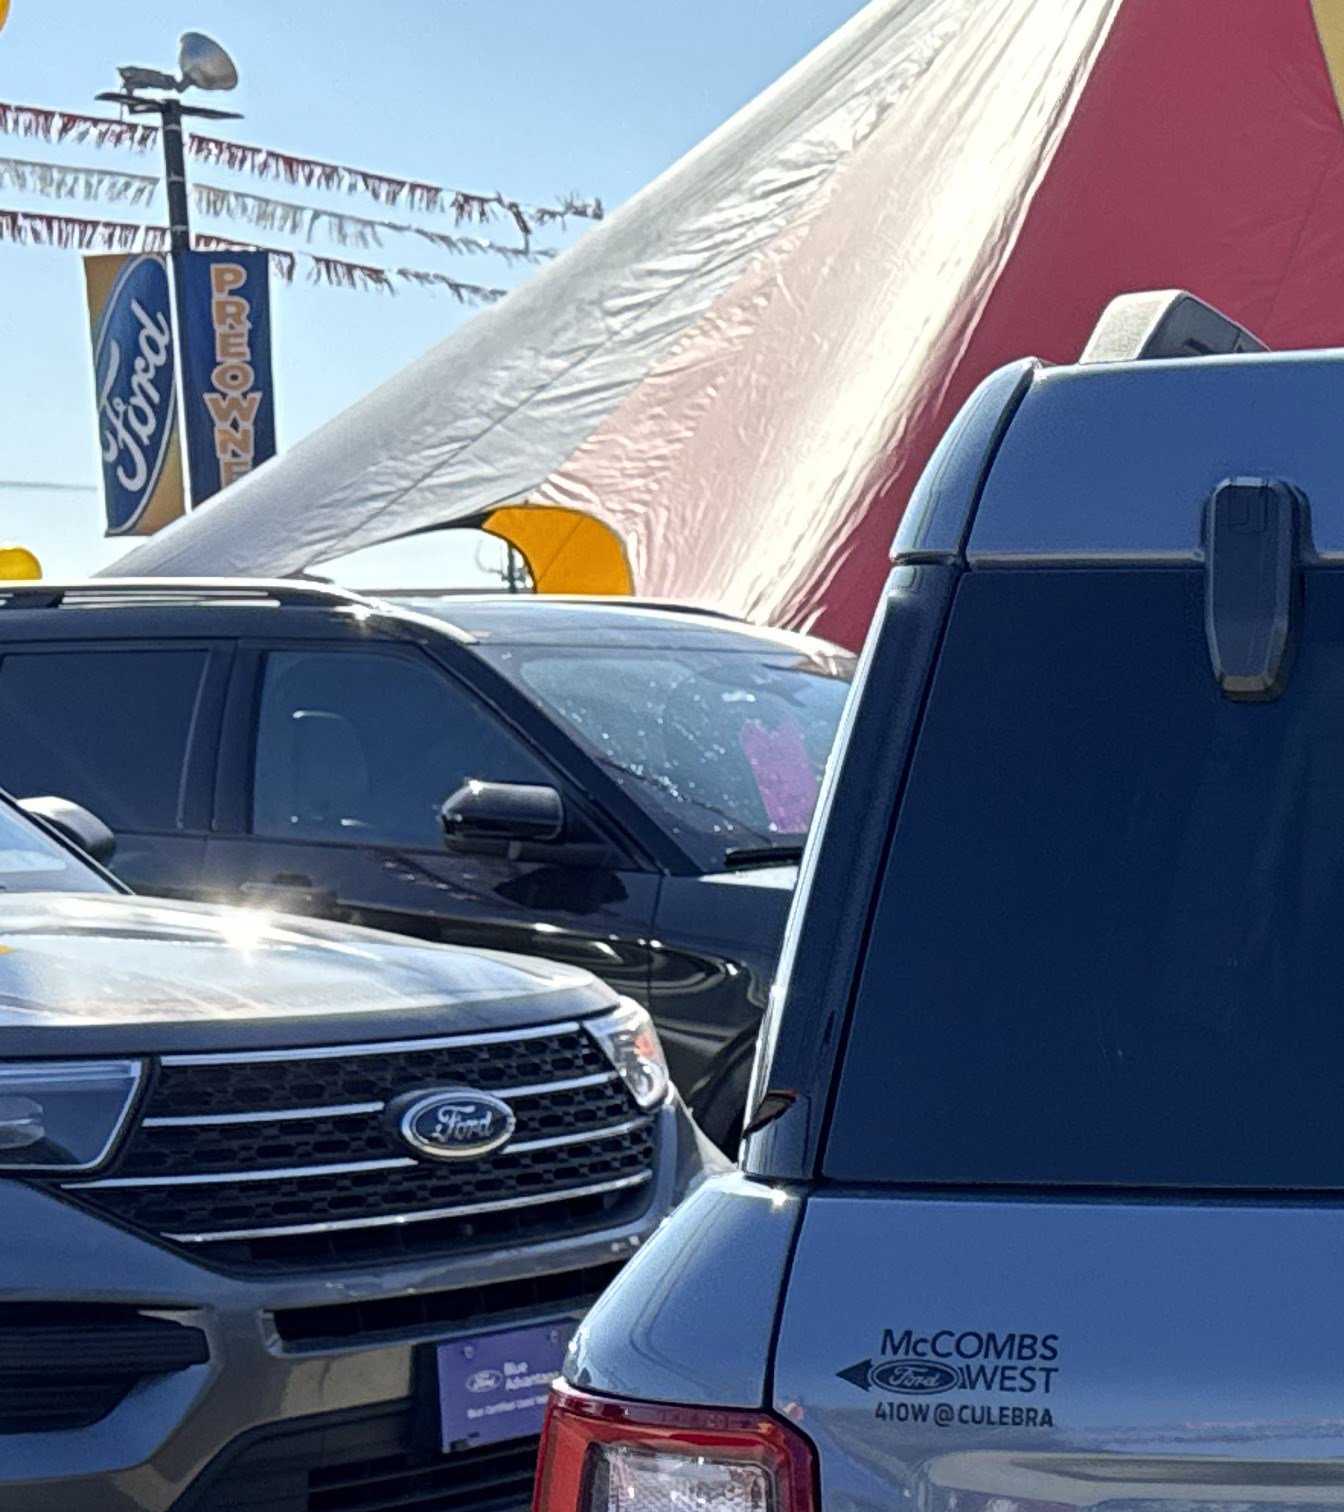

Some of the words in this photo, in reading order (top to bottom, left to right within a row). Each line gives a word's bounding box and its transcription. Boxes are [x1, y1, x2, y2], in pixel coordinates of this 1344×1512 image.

[203, 262, 262, 490] PREOWNE
[99, 298, 172, 493] Ford
[431, 1105, 493, 1142] Ford
[881, 1328, 1059, 1361] McCOMBS
[888, 1366, 941, 1387] Ford
[965, 1364, 1059, 1393] WEST
